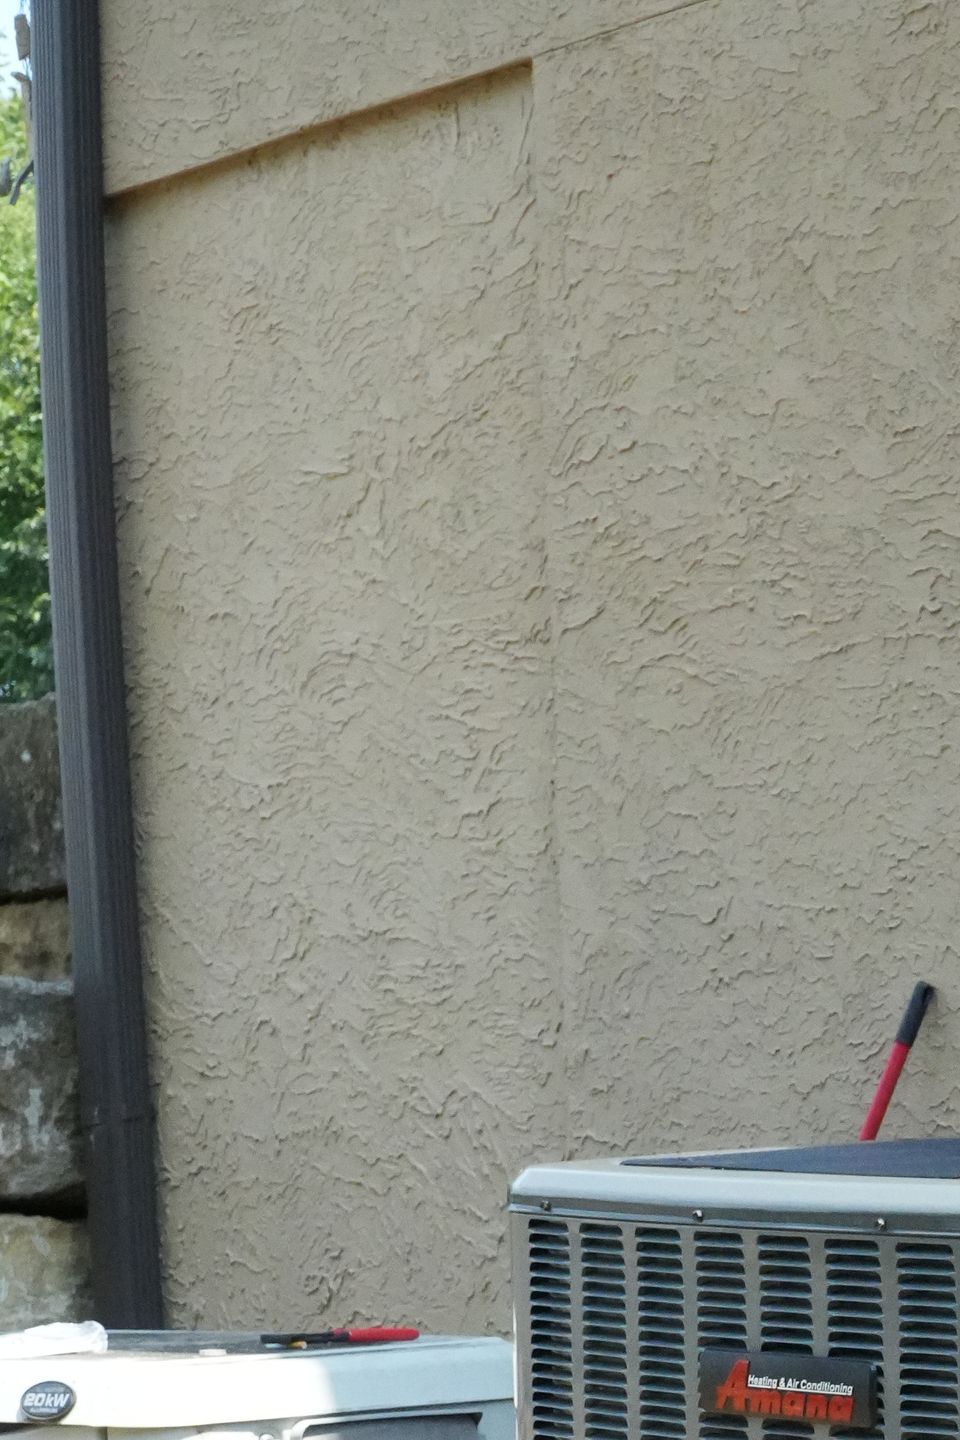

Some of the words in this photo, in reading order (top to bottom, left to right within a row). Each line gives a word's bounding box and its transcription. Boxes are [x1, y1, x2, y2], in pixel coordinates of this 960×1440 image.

[715, 1359, 854, 1423] Amana
[748, 1374, 778, 1388] Heating
[779, 1377, 786, 1388] &
[786, 1378, 800, 1389] Air
[800, 1379, 854, 1396] Conditioning
